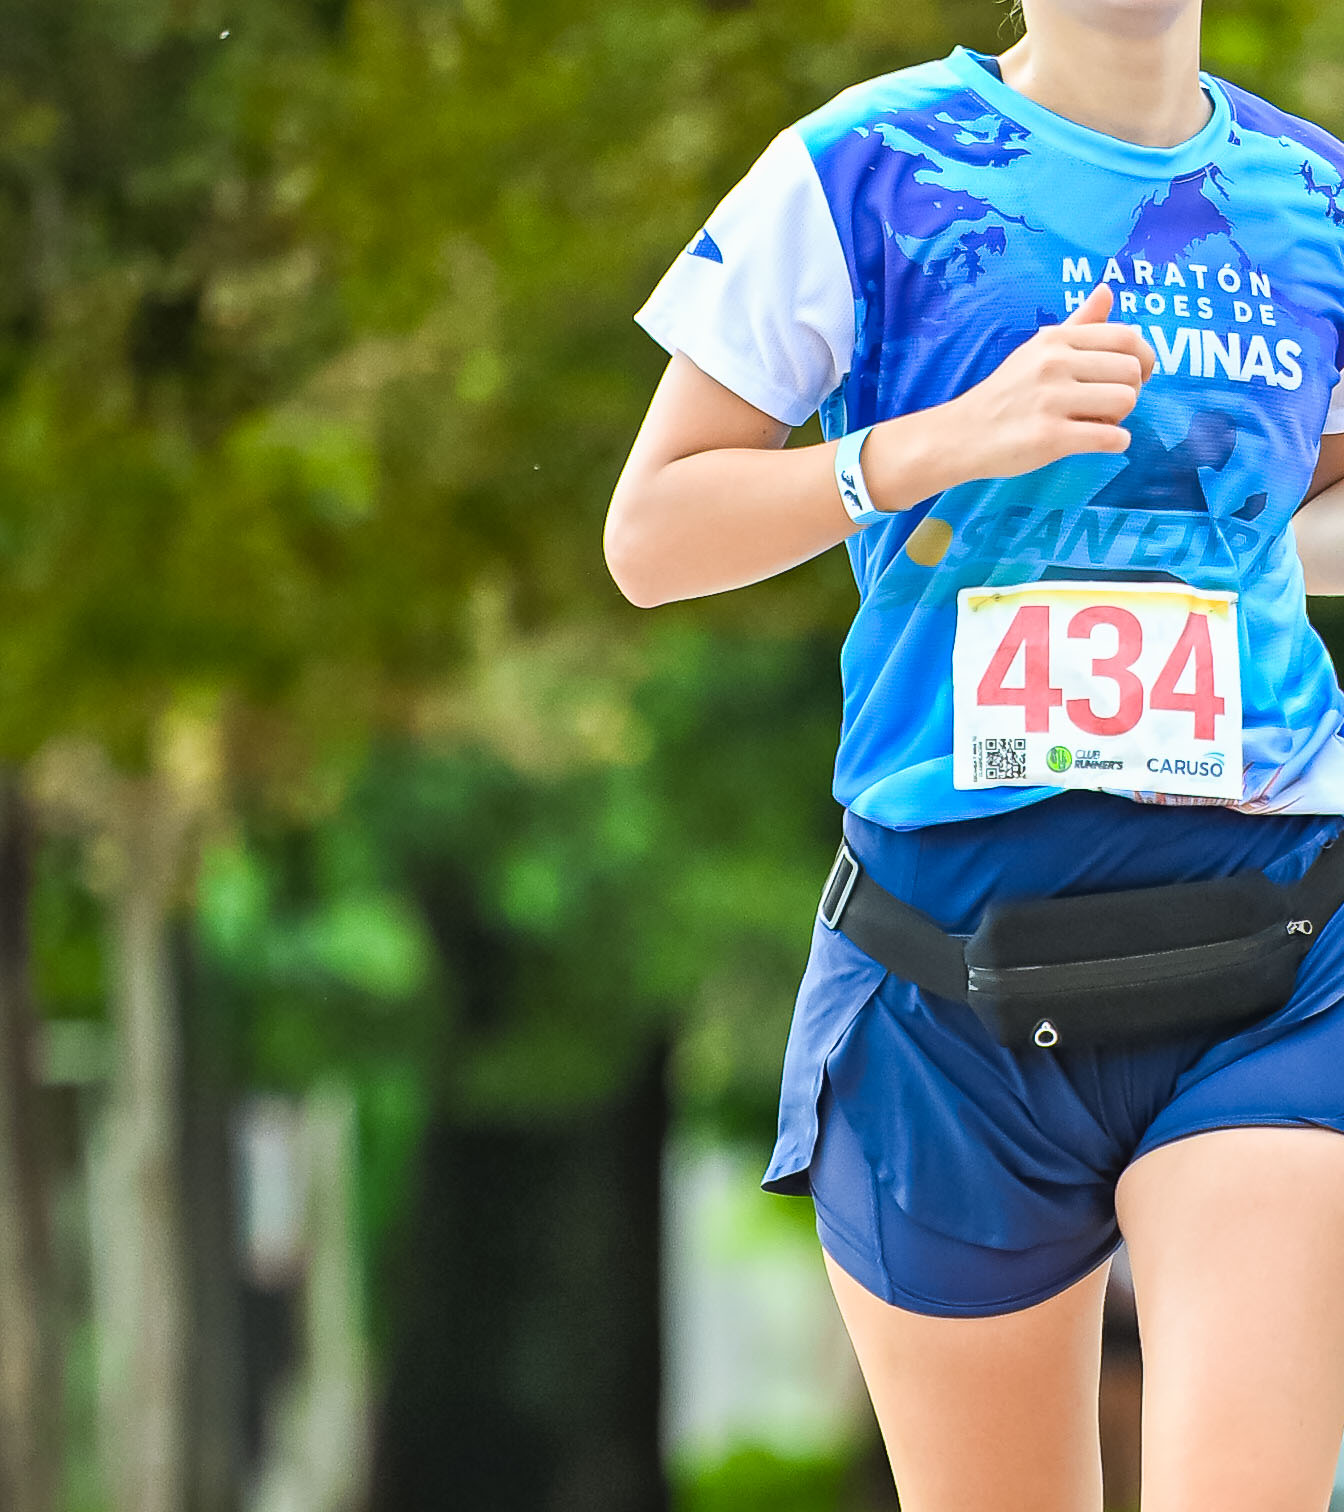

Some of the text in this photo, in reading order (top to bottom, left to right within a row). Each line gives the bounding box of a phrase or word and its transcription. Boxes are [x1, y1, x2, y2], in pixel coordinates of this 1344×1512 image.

[1062, 257, 1272, 298] MARATÓN
[1064, 290, 1277, 326] HROES DE
[1039, 324, 1303, 391] VINAS
[976, 605, 1225, 741] 434
[1146, 757, 1223, 778] CARUSO
